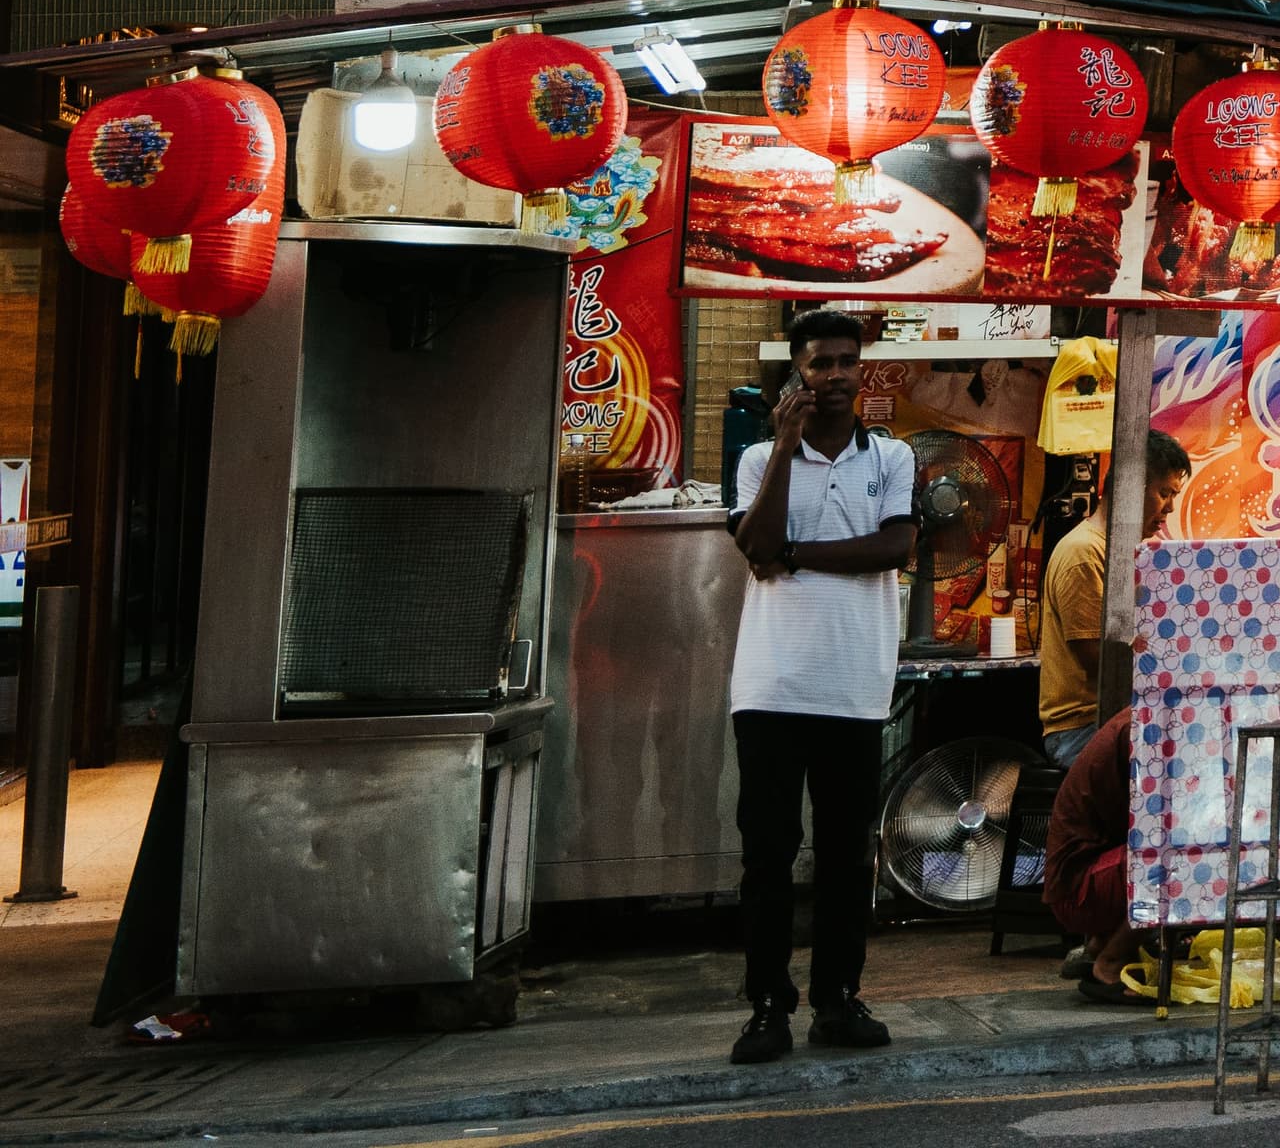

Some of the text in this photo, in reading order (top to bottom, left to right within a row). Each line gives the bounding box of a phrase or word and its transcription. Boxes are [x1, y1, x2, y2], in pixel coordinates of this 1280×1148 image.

[880, 61, 929, 89] KEE
[1205, 92, 1280, 124] LOONG
[1213, 123, 1272, 148] KEE
[562, 401, 624, 428] ONG
